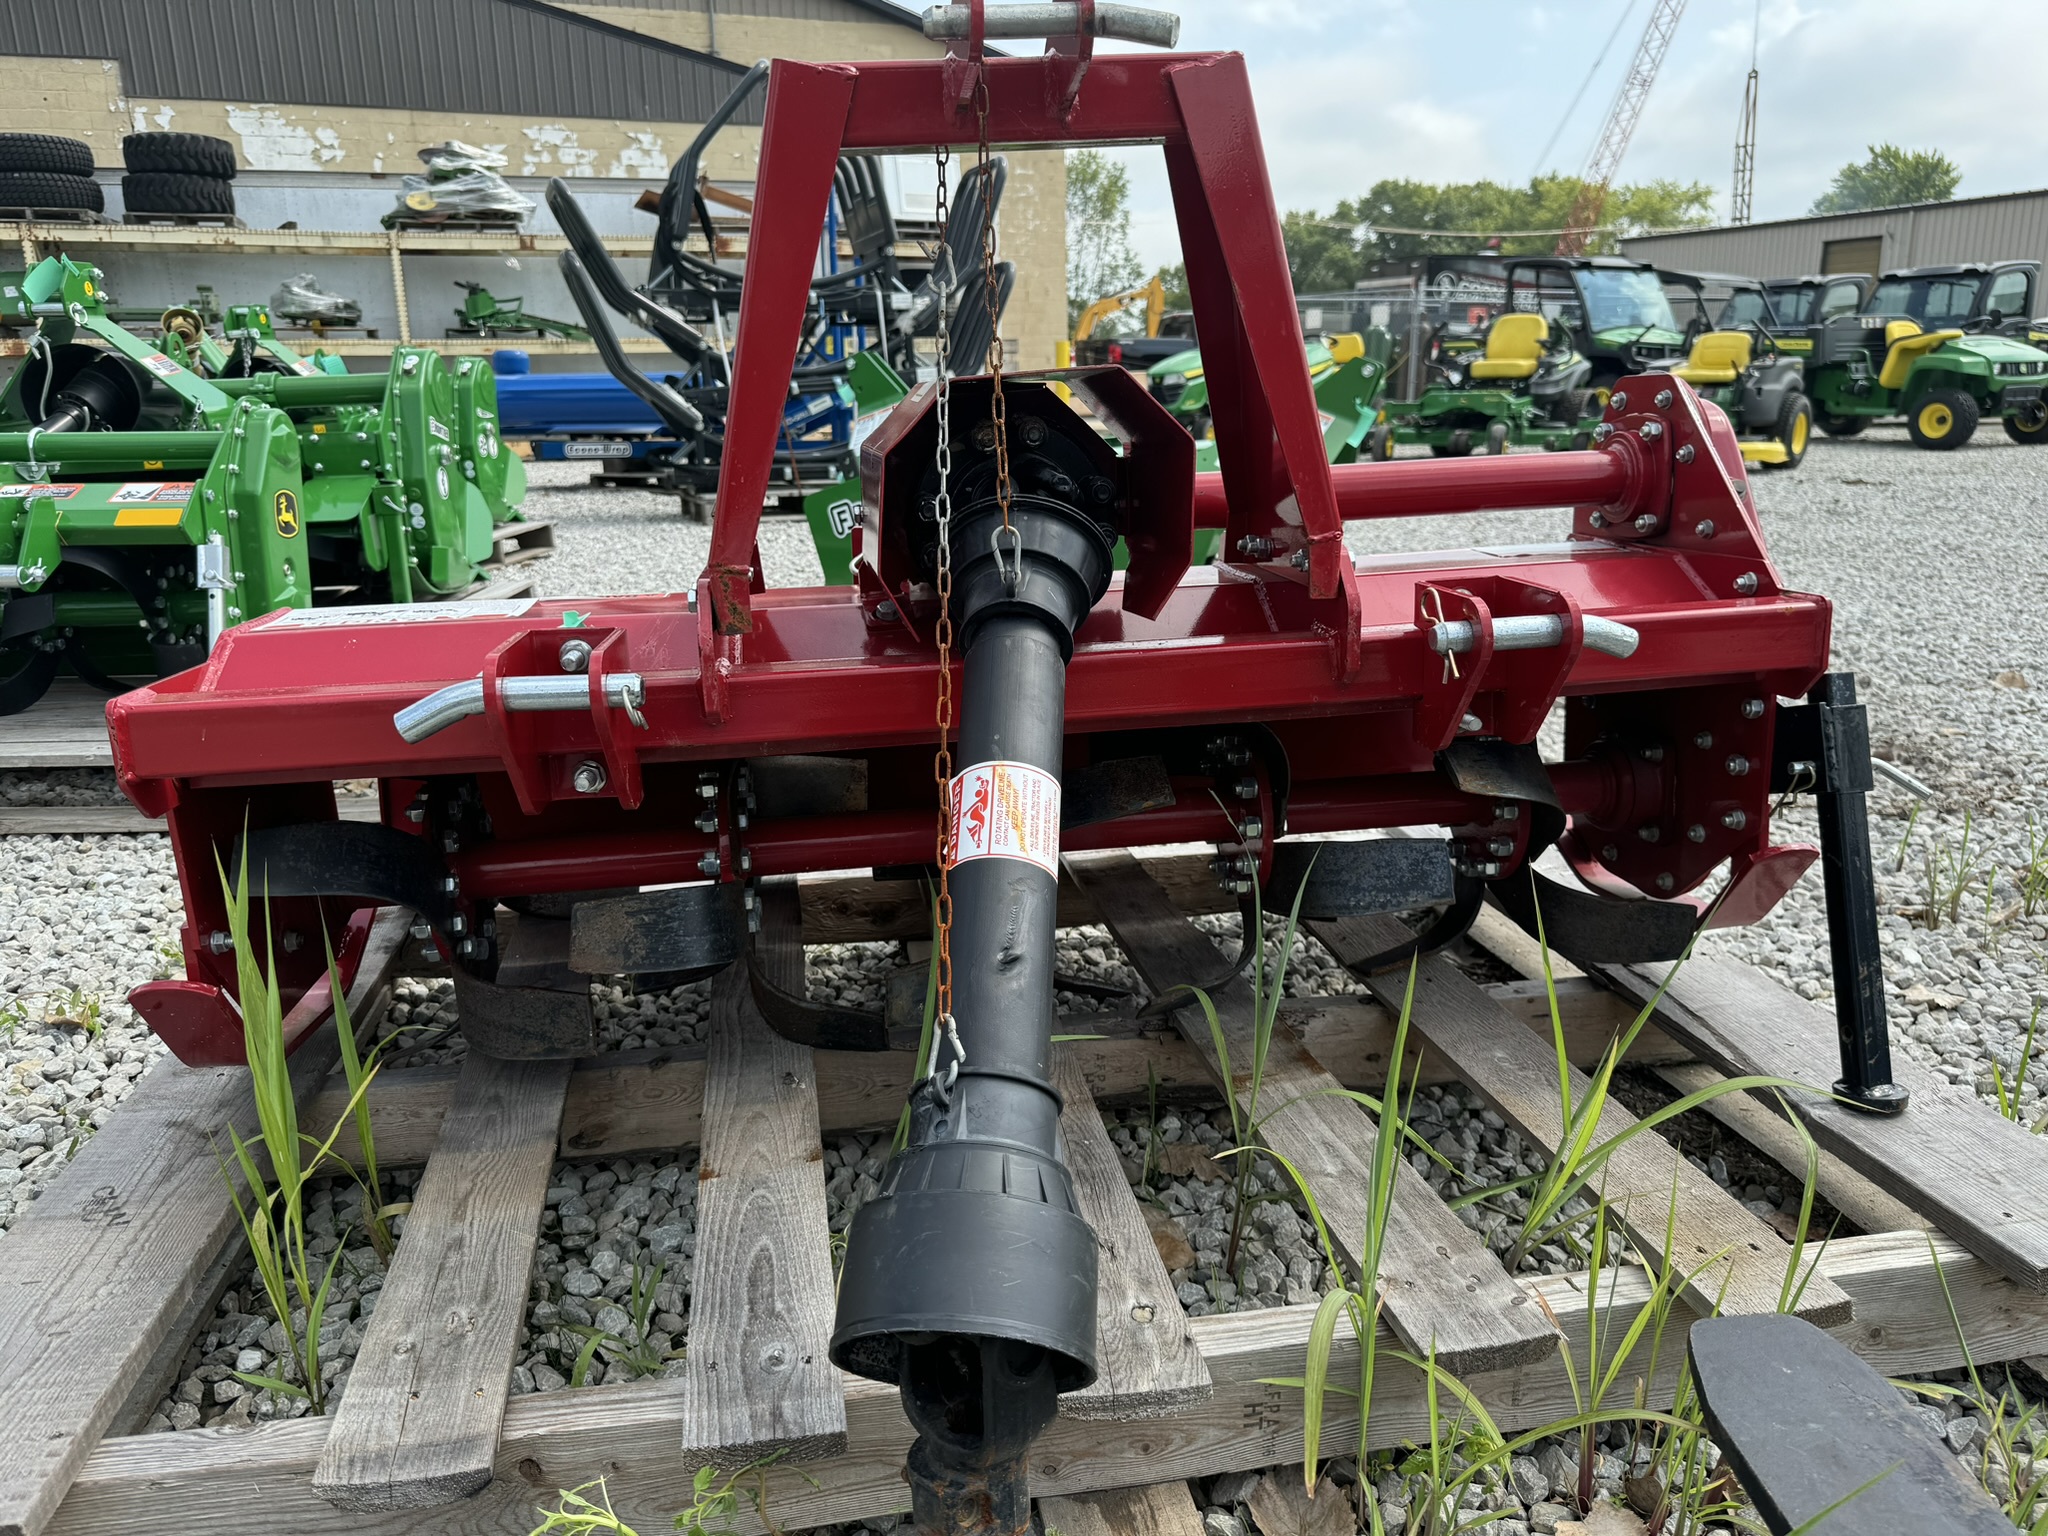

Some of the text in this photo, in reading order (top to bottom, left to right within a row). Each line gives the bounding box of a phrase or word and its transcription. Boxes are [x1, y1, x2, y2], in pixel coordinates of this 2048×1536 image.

[950, 781, 961, 844] DANGER
[995, 772, 1006, 845] ROTATING DRIVELINE
[1011, 811, 1019, 831] KEEP
[1243, 1402, 1264, 1430] HT
